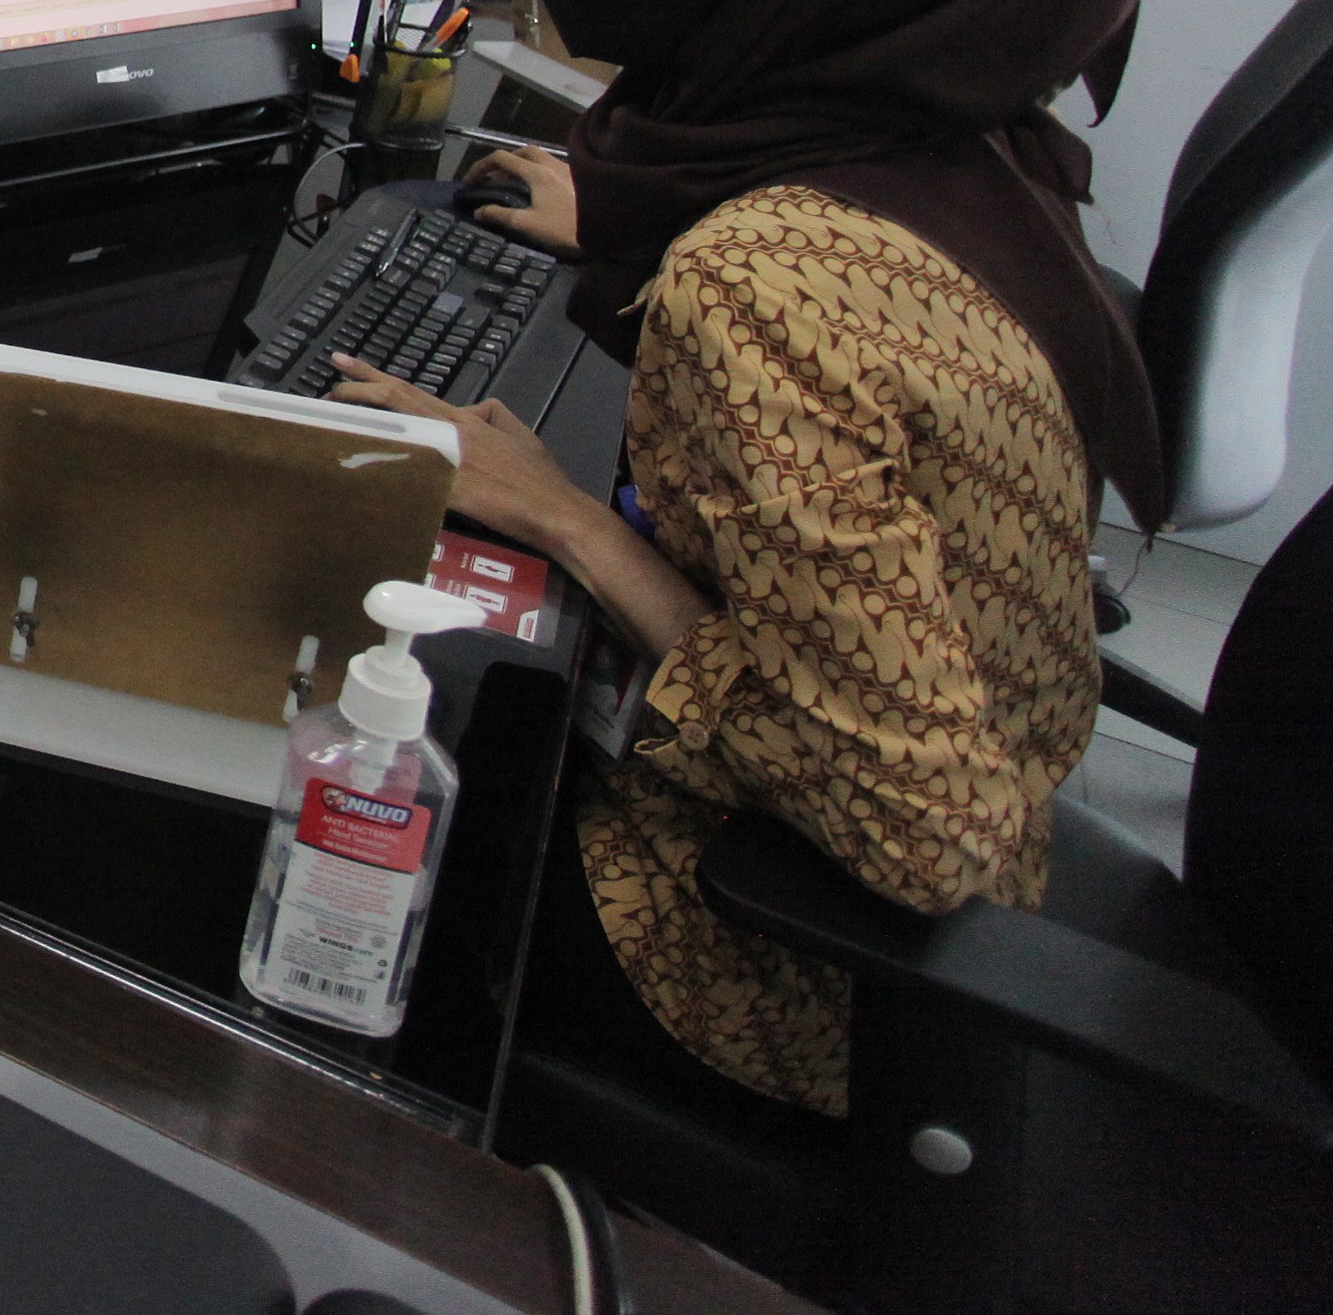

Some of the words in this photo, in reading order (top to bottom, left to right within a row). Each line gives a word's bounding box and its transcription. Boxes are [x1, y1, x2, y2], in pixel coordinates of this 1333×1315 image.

[345, 795, 410, 824] NUVO
[322, 815, 346, 827] ANTI
[348, 822, 398, 842] BACTERIAL
